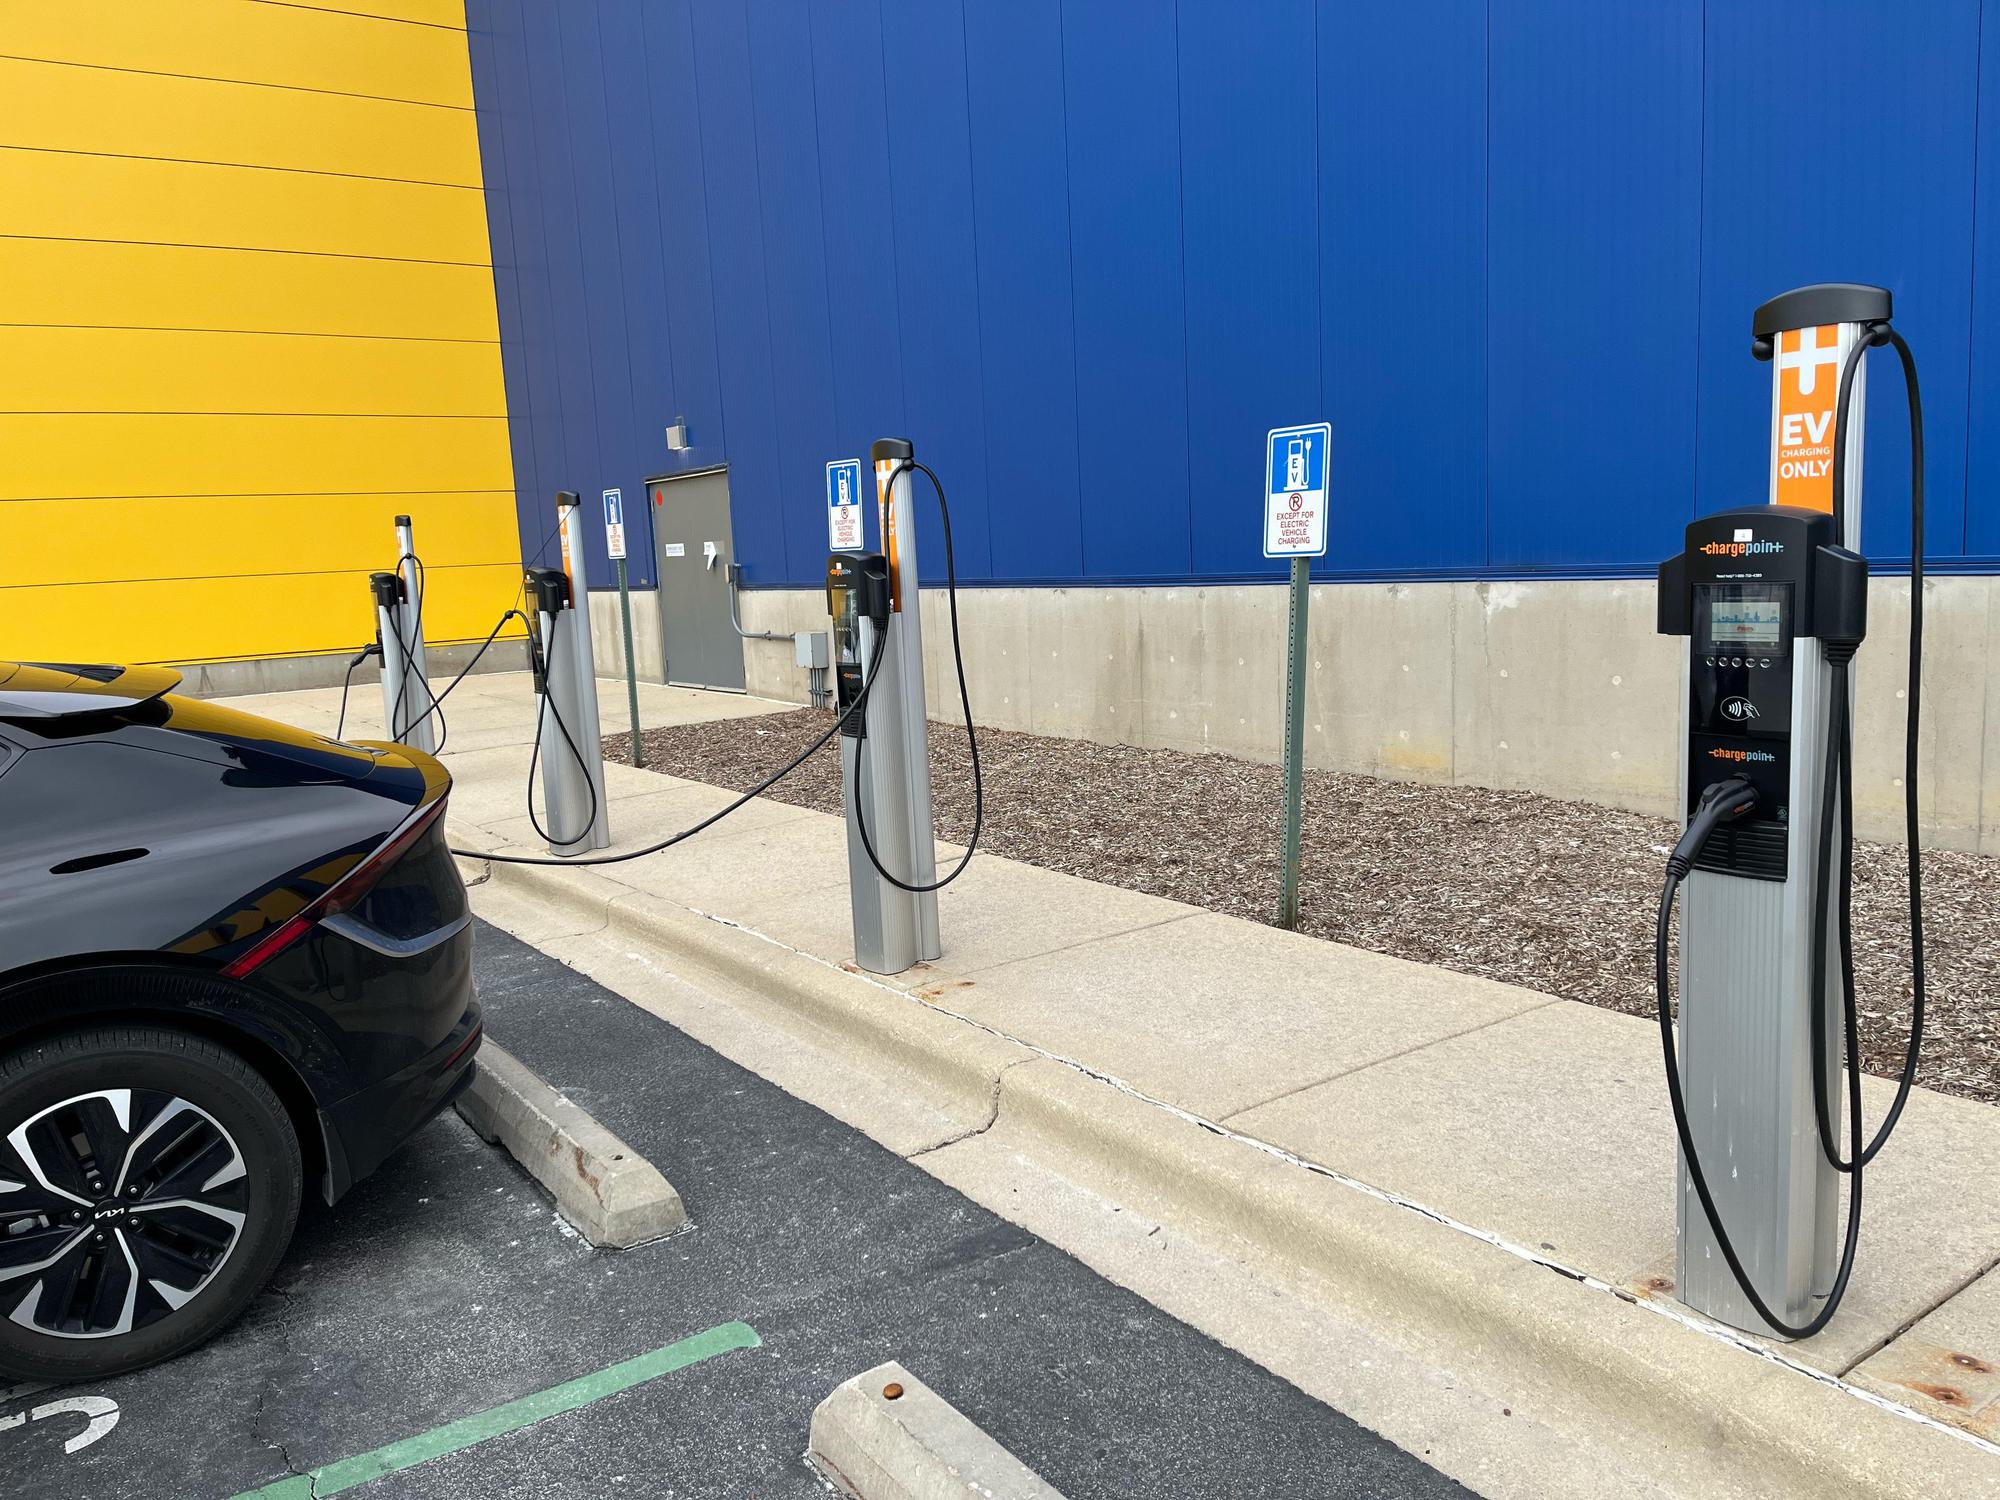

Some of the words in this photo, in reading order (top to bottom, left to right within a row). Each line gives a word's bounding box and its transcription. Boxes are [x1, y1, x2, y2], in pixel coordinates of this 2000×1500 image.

[1782, 411, 1832, 446] EV
[1781, 447, 1830, 457] CHARGING
[1781, 460, 1831, 479] ONLY
[1277, 512, 1300, 520] EXCEPT
[1280, 519, 1309, 528] ELECTRIC
[1282, 528, 1307, 536] VEHICLE
[1278, 537, 1310, 545] CHARGING
